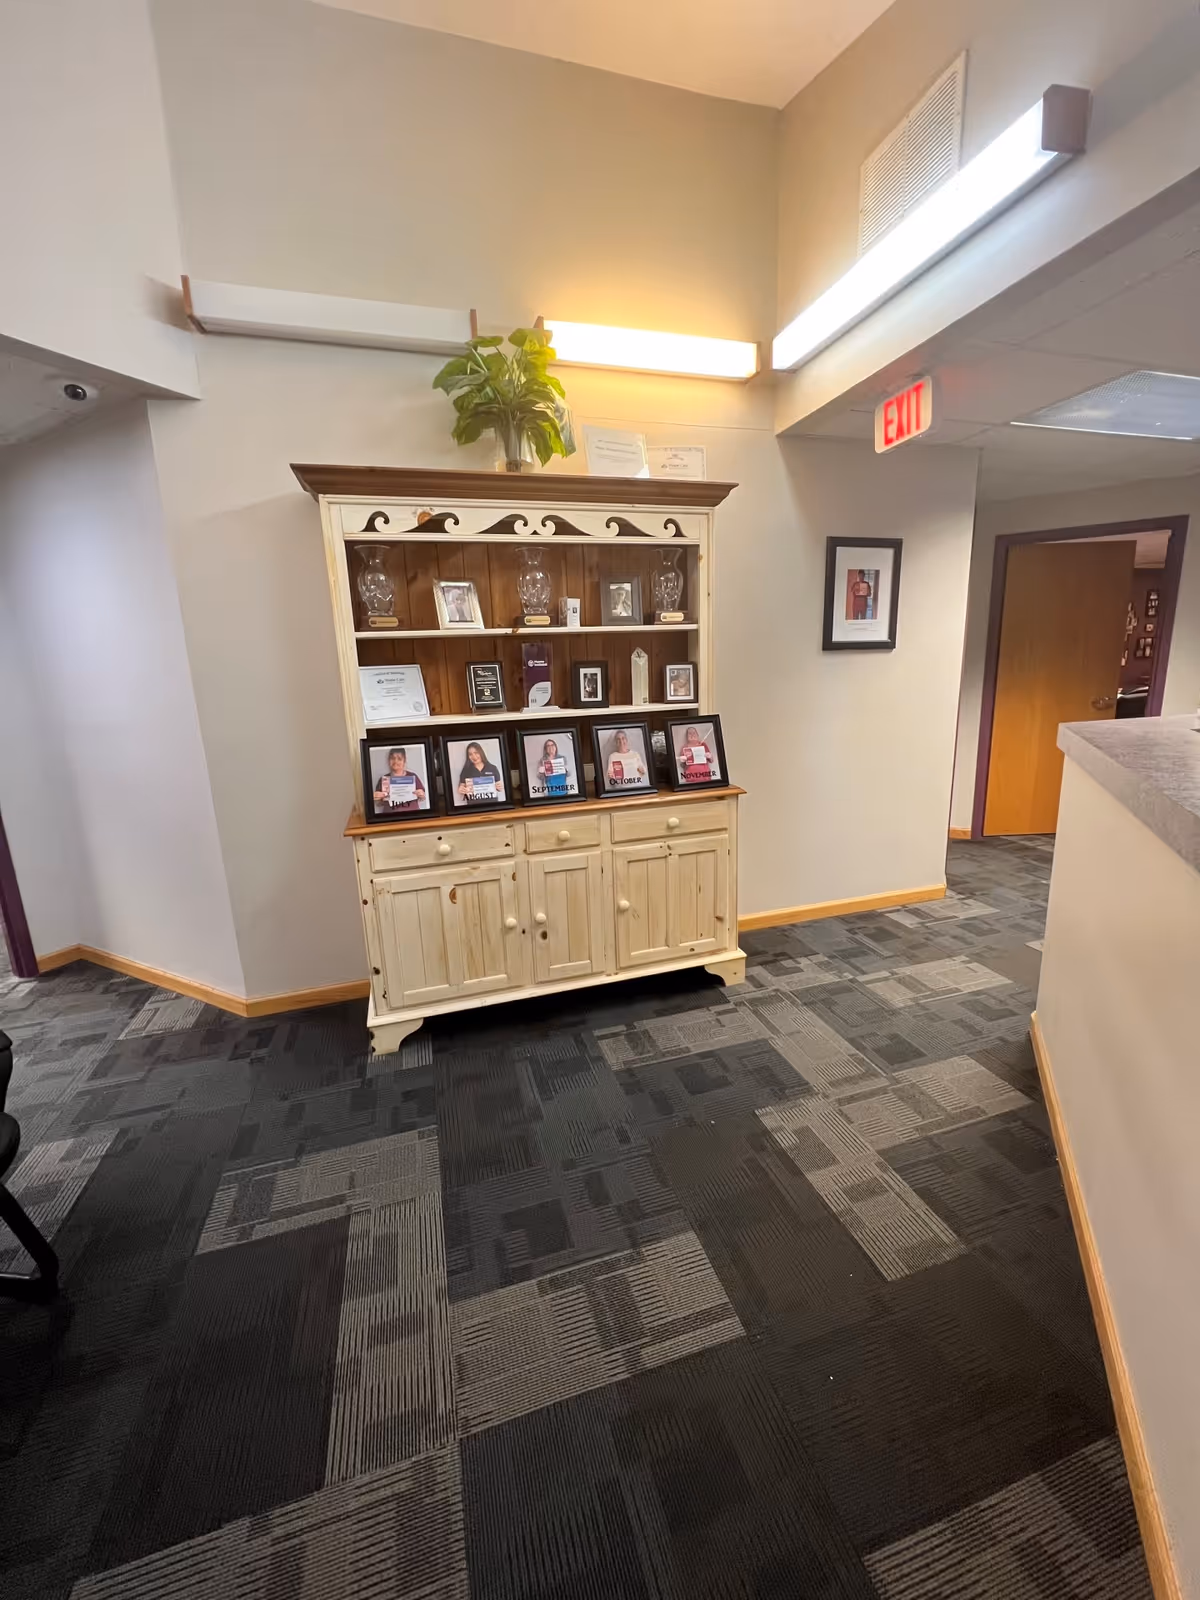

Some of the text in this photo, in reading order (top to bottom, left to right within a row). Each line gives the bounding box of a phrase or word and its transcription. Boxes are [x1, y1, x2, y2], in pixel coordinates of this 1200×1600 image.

[883, 381, 924, 447] EXIT
[680, 770, 717, 780] NOVEMBER
[608, 777, 642, 786] OCTOBER
[531, 784, 575, 794] SEPTEMBER
[462, 792, 495, 802] AUGUST
